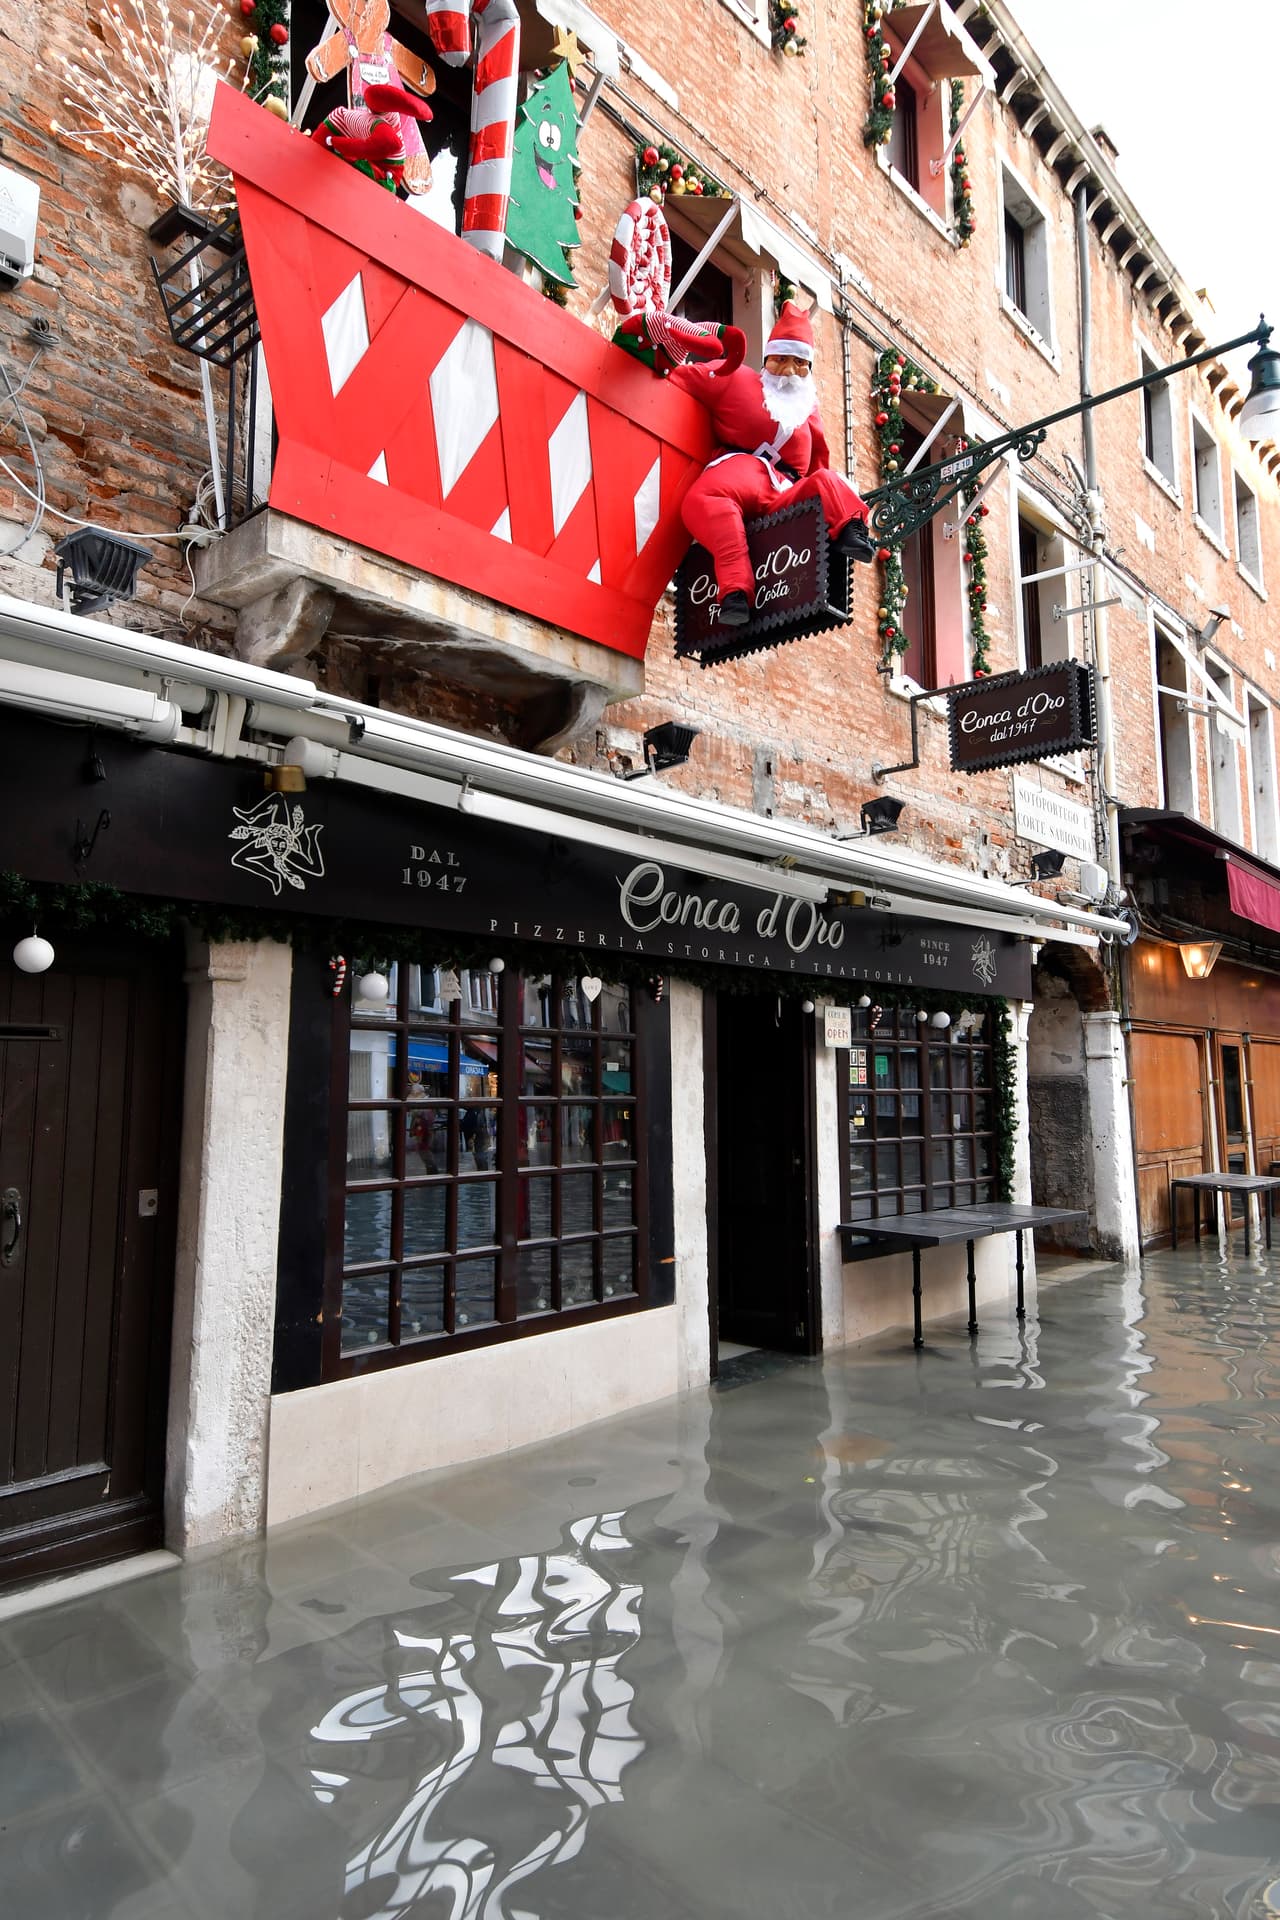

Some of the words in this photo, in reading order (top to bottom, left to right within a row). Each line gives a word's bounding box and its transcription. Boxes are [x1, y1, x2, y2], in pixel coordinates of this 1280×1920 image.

[755, 545, 811, 580] d'Oro
[755, 580, 790, 609] Costa
[959, 711, 1012, 733] Conca
[1017, 693, 1065, 717] d'Oro
[990, 727, 1007, 742] dal
[1007, 717, 1038, 738] 1947
[1018, 788, 1079, 825] SOTOPORTEGO
[1017, 812, 1046, 836] CORTE
[409, 845, 460, 867] DAL
[401, 867, 467, 893] 1947
[615, 862, 740, 934] Conca
[756, 893, 845, 953] d'Oro
[490, 919, 644, 951] PIZZERIA
[667, 942, 770, 967] STORICA
[790, 959, 796, 969] E
[813, 962, 913, 984] TRATTORIA
[920, 938, 950, 952] SINCE
[922, 953, 949, 967] 1947
[827, 1028, 849, 1040] OPEN
